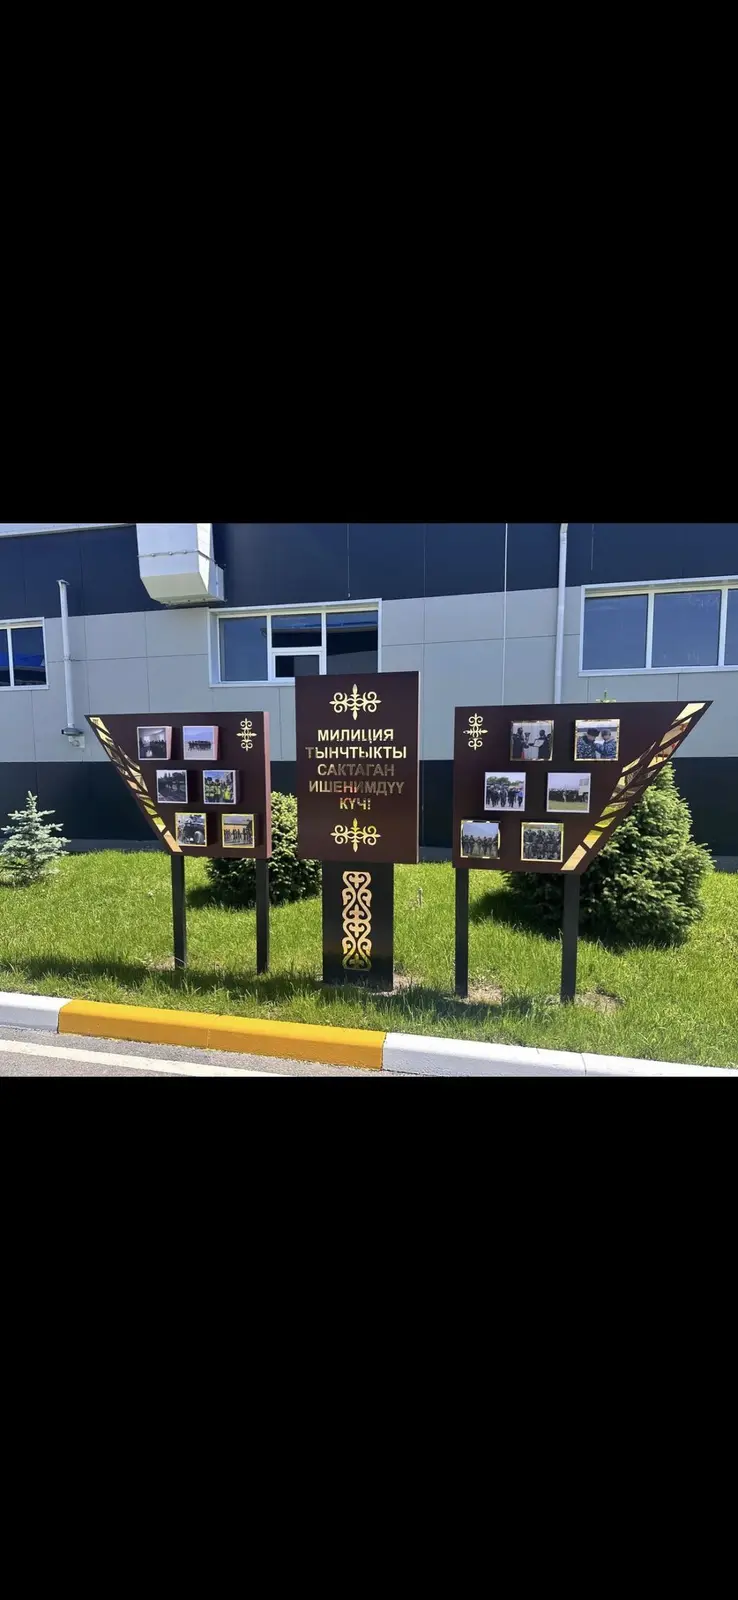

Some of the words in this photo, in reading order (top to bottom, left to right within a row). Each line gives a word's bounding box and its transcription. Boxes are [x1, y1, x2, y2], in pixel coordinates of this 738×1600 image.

[317, 728, 394, 744] МИЛИЦИЯ
[305, 746, 407, 759] ТЫНЧТЫКТЫ
[317, 763, 395, 776] САКТАГАН
